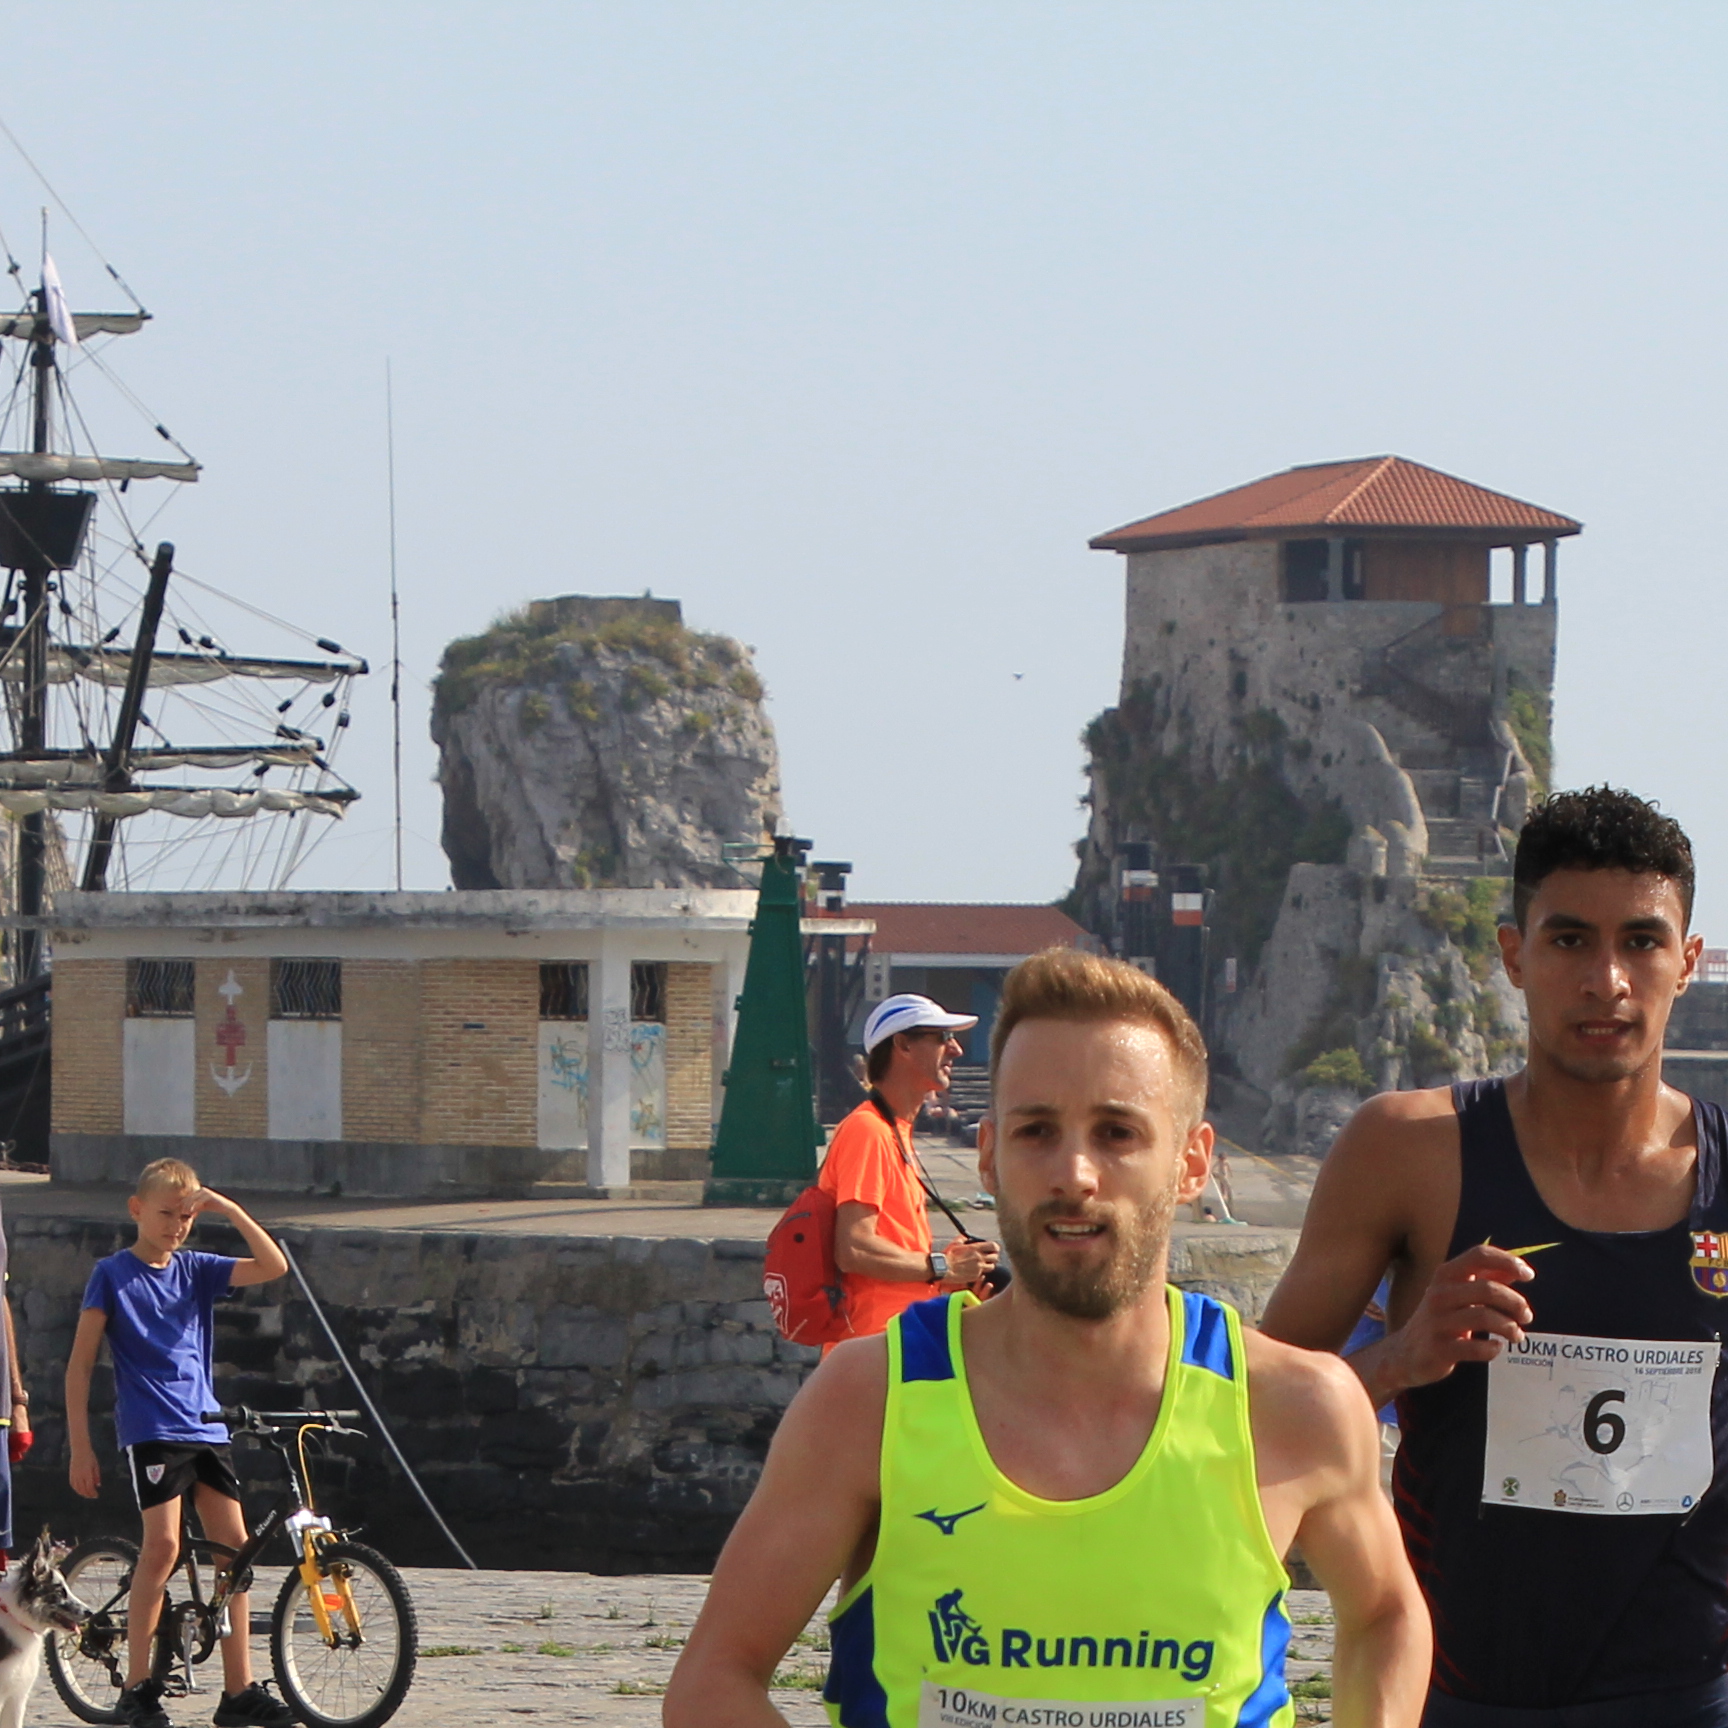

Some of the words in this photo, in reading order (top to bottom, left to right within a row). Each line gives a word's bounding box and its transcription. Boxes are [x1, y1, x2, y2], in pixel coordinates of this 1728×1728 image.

[1562, 1344, 1629, 1363] CASTRO
[1633, 1349, 1704, 1366] URDIALES
[1582, 1389, 1626, 1455] 6
[1001, 1629, 1215, 1682] Running
[937, 1688, 997, 1721] 10KM
[1002, 1706, 1084, 1728] CASTRO
